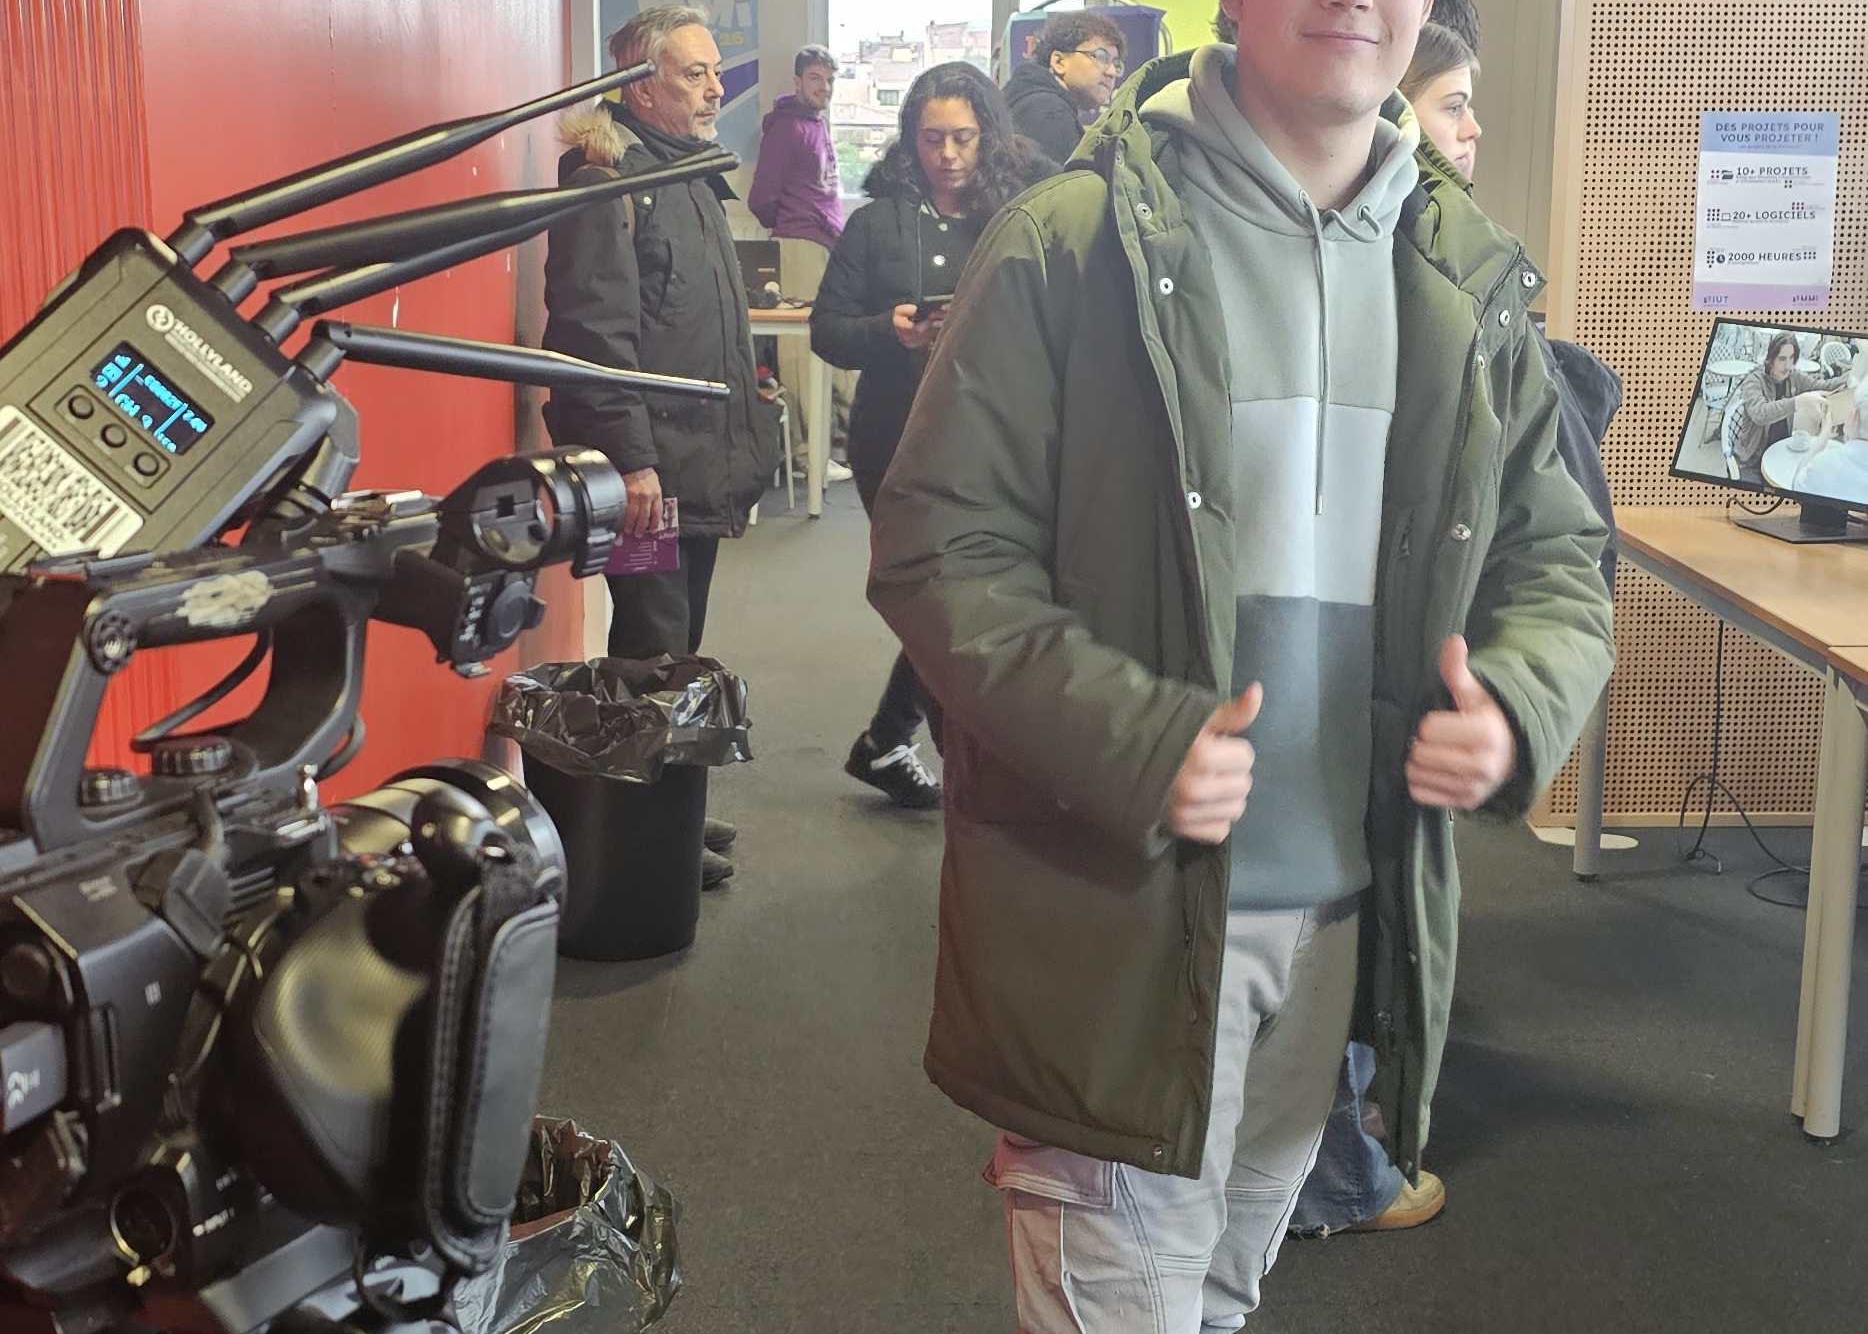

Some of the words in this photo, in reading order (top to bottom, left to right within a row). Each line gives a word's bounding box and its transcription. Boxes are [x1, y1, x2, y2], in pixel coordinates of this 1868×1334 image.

[1715, 122, 1737, 132] DES
[1740, 122, 1790, 132] PROJETS
[1793, 122, 1825, 132] POUR
[1720, 133, 1751, 143] VOUS
[1754, 133, 1812, 143] PROJETER
[1736, 167, 1755, 176] 10+
[1759, 167, 1809, 175] PROJETS
[1732, 211, 1752, 220] 20+
[1755, 210, 1816, 220] LOGICIELS
[1728, 252, 1755, 261] 2000
[1758, 252, 1802, 261] HEURES
[1712, 295, 1729, 303] IUT
[170, 318, 253, 393] HOLLYLAND
